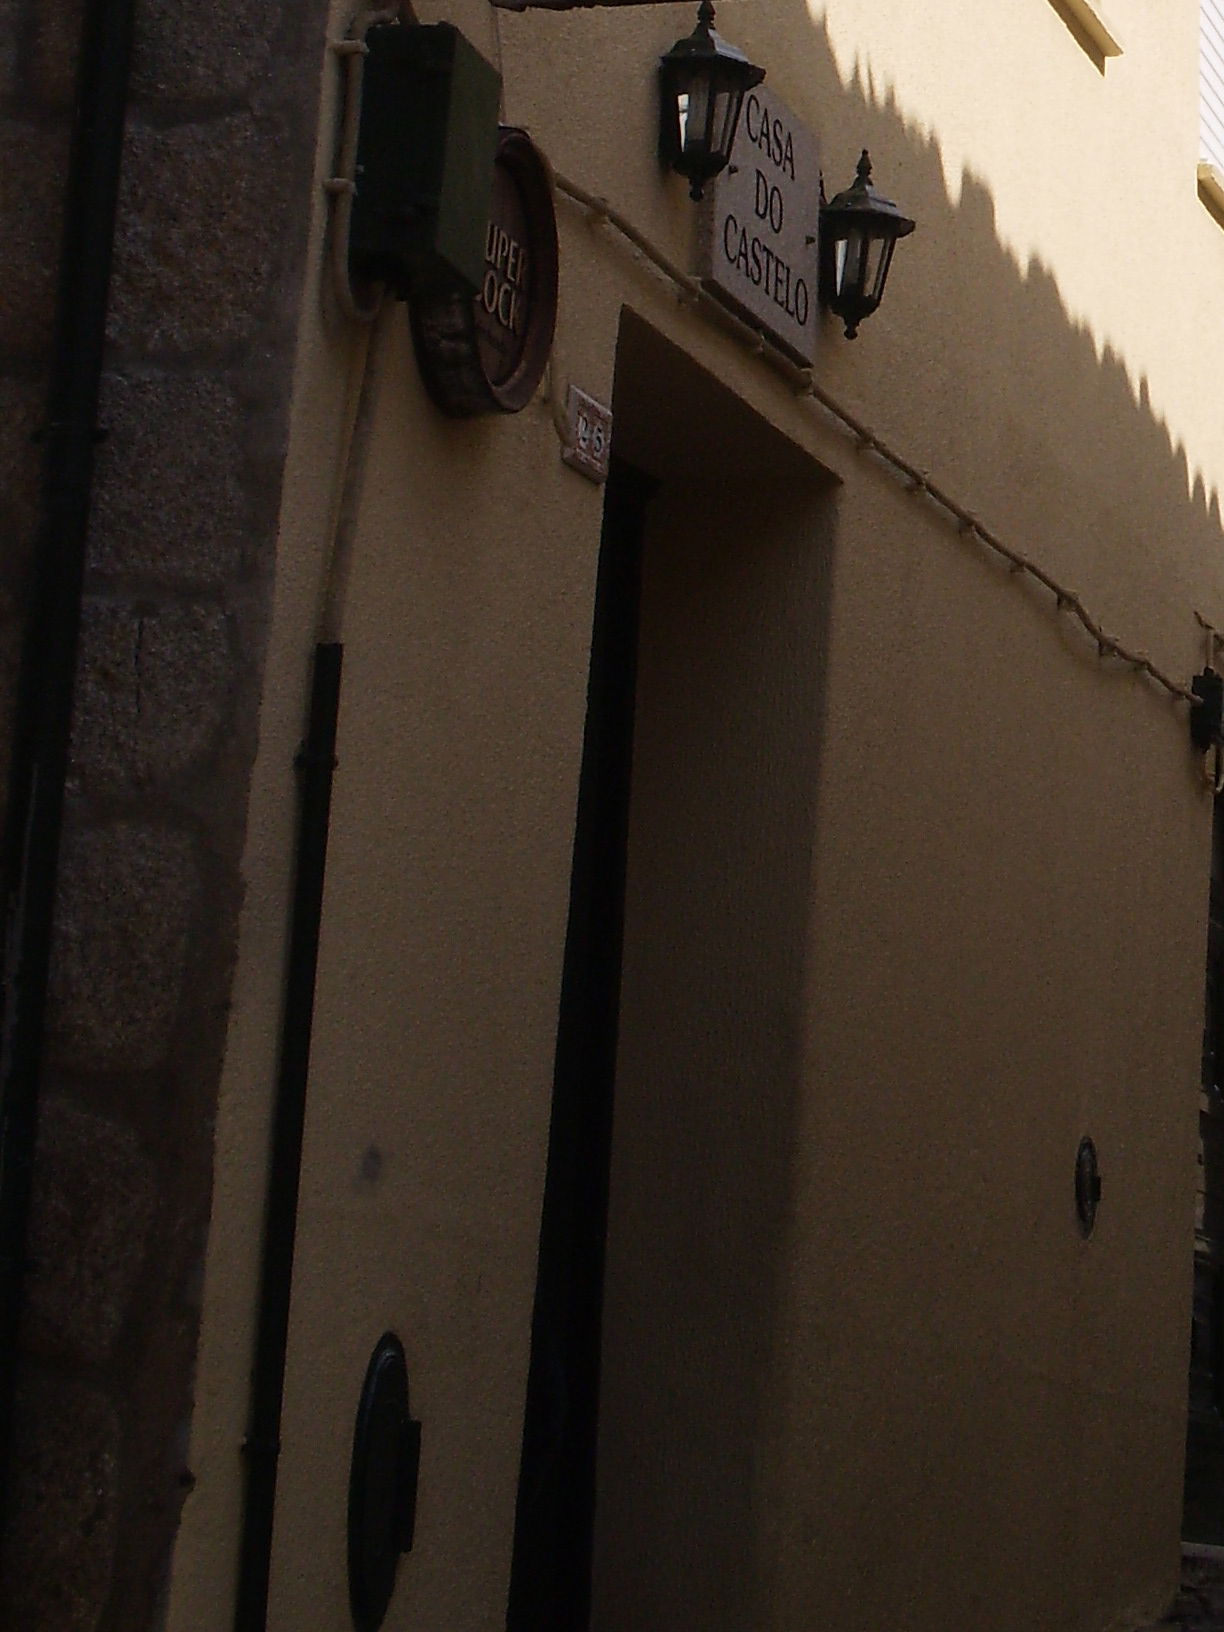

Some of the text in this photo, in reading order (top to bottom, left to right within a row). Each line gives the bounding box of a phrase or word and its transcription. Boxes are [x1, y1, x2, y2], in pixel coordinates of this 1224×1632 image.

[746, 94, 796, 181] CASA
[755, 169, 784, 234] DO
[723, 215, 809, 327] CASTELO
